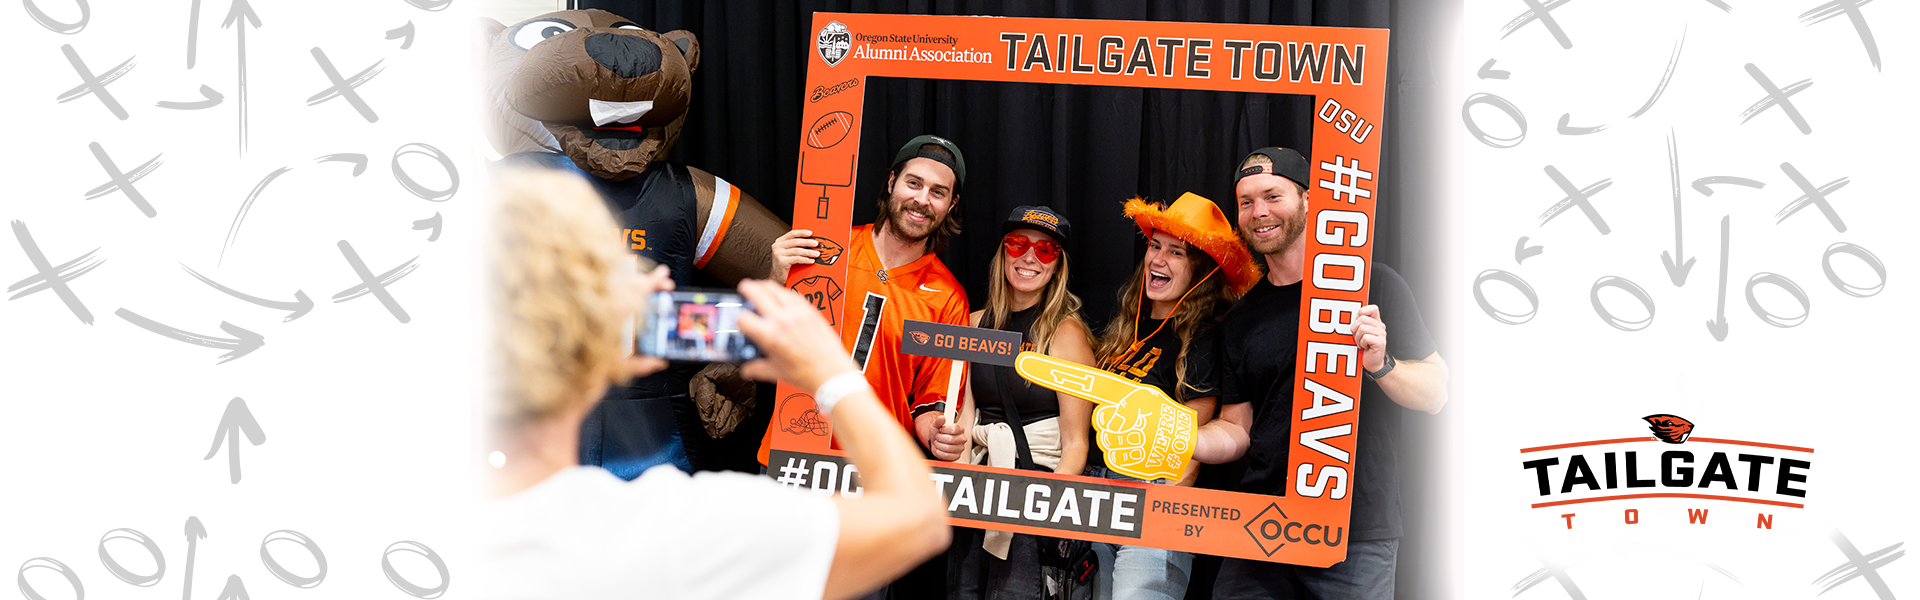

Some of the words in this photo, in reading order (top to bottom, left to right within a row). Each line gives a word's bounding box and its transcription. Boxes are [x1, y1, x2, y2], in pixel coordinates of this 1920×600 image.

[855, 32, 889, 45] Oregon
[889, 33, 912, 43] State
[912, 34, 959, 47] University
[853, 44, 908, 61] Alumni
[908, 46, 993, 64] Association
[1000, 32, 1213, 79] TAILGATE
[1223, 40, 1366, 86] TOWN
[810, 78, 859, 103] Beavers
[1318, 97, 1375, 144] OSU
[1295, 155, 1373, 500] #GOBEAVS
[933, 332, 954, 349] GO
[958, 336, 1012, 356] BEAVS!
[1050, 367, 1095, 393] 1
[1145, 403, 1176, 467] WE'RE
[1166, 410, 1192, 470] #ONE
[1151, 500, 1241, 521] PRESENTED
[1183, 524, 1204, 538] BY
[1260, 519, 1343, 547] OCCU
